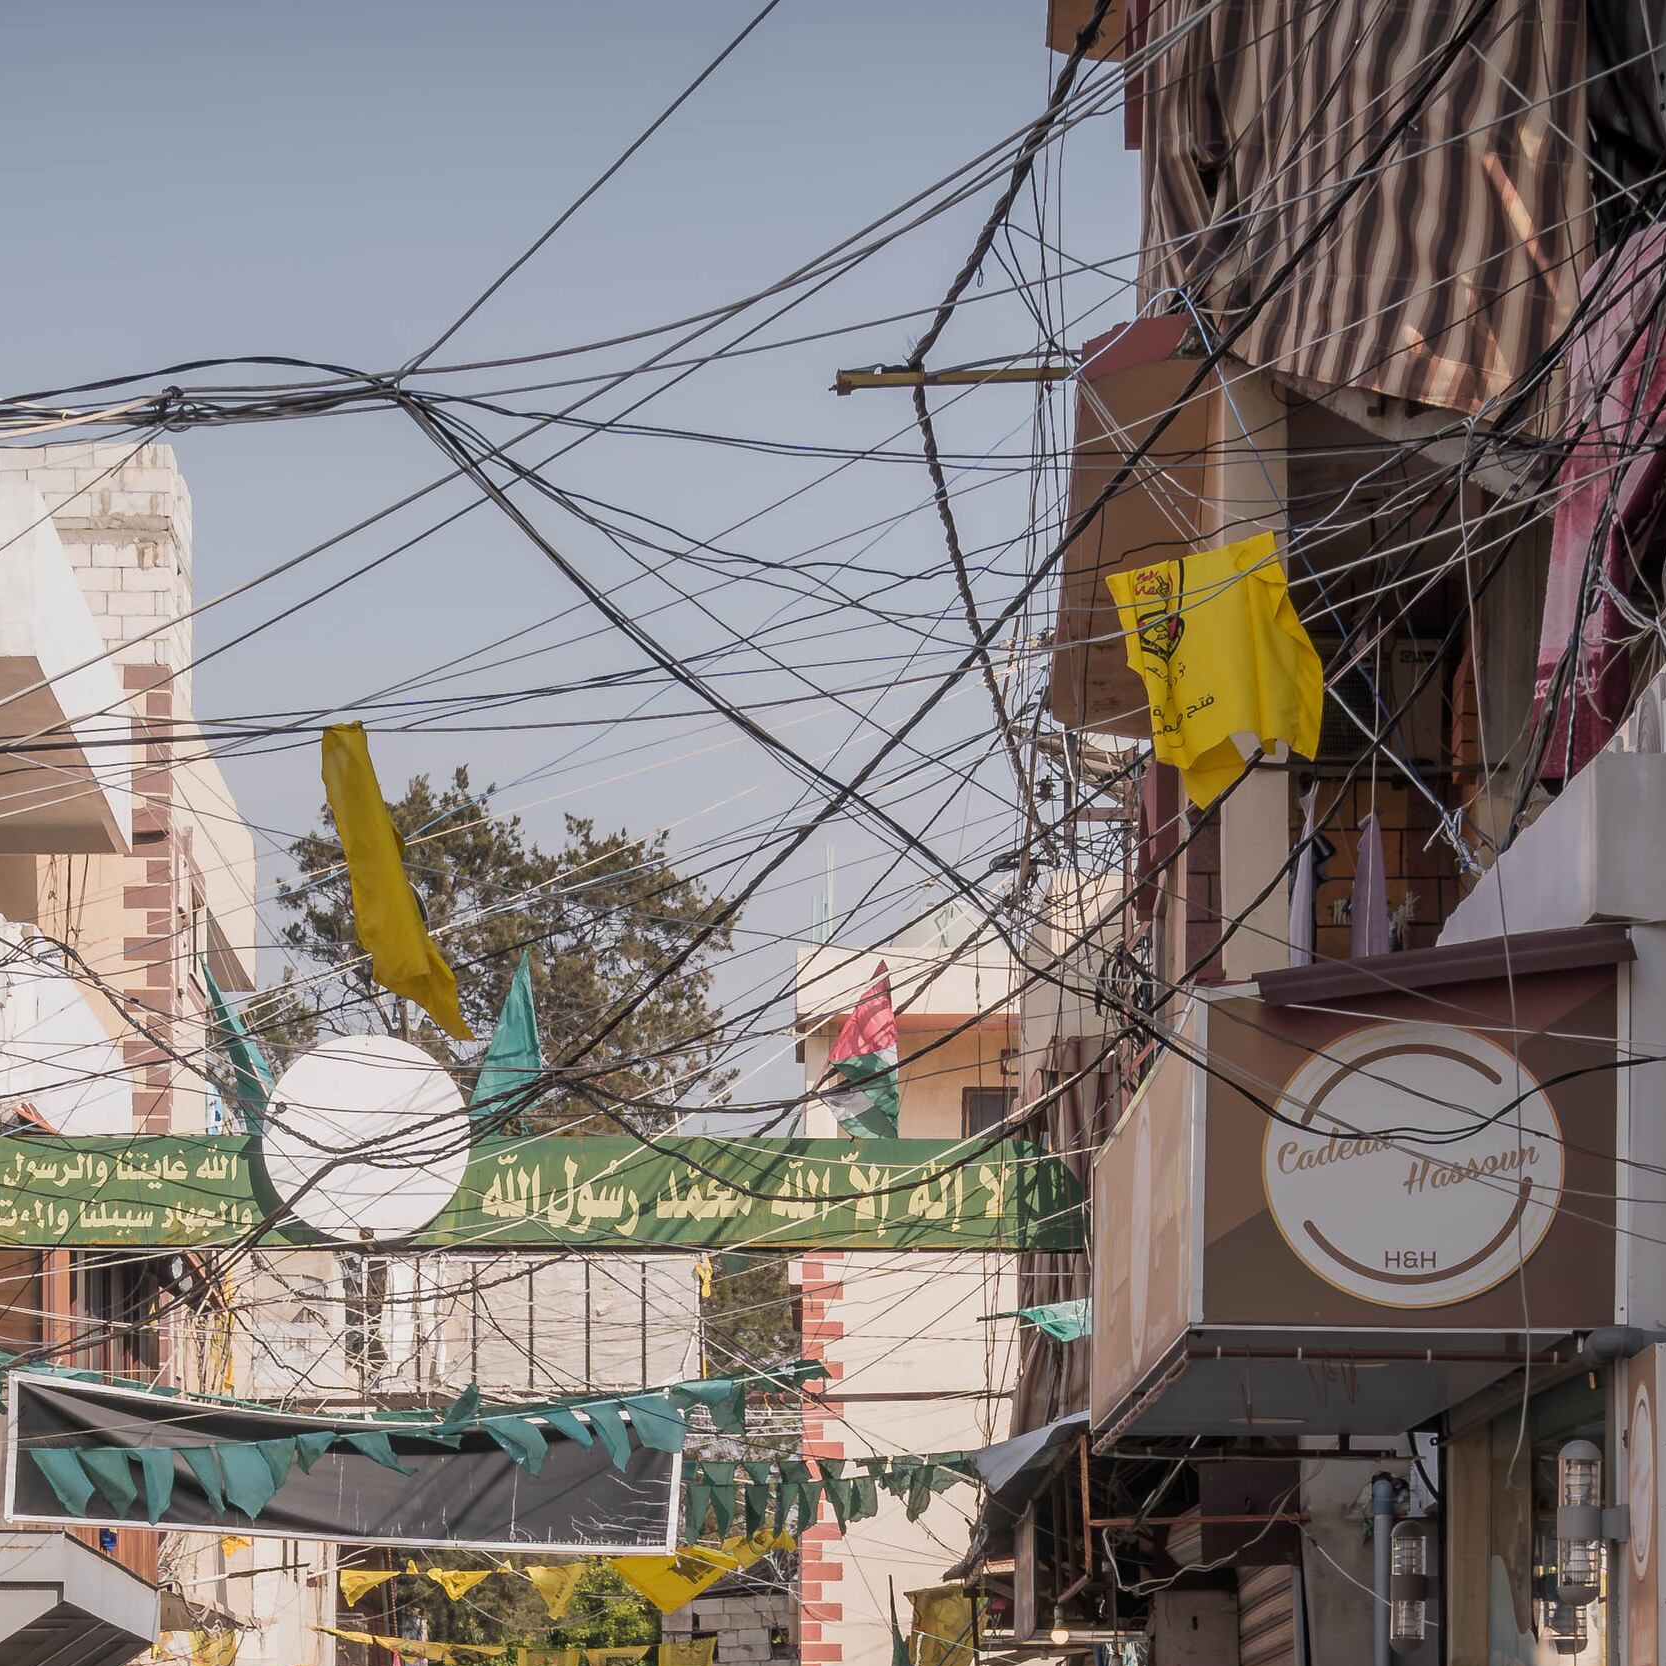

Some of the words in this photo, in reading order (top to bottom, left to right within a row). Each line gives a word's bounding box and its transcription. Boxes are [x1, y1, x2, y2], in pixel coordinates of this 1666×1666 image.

[3, 1151, 108, 1188] والرسول
[117, 1149, 189, 1190] غايتنا
[196, 1144, 239, 1182] الله
[1277, 1126, 1394, 1175] Cadeau
[979, 1160, 1011, 1218] لا
[1403, 1145, 1540, 1196] Hassoun
[79, 1198, 155, 1237] سبيلنا
[161, 1200, 254, 1237] والجهاد
[1384, 1250, 1437, 1269] H&H
